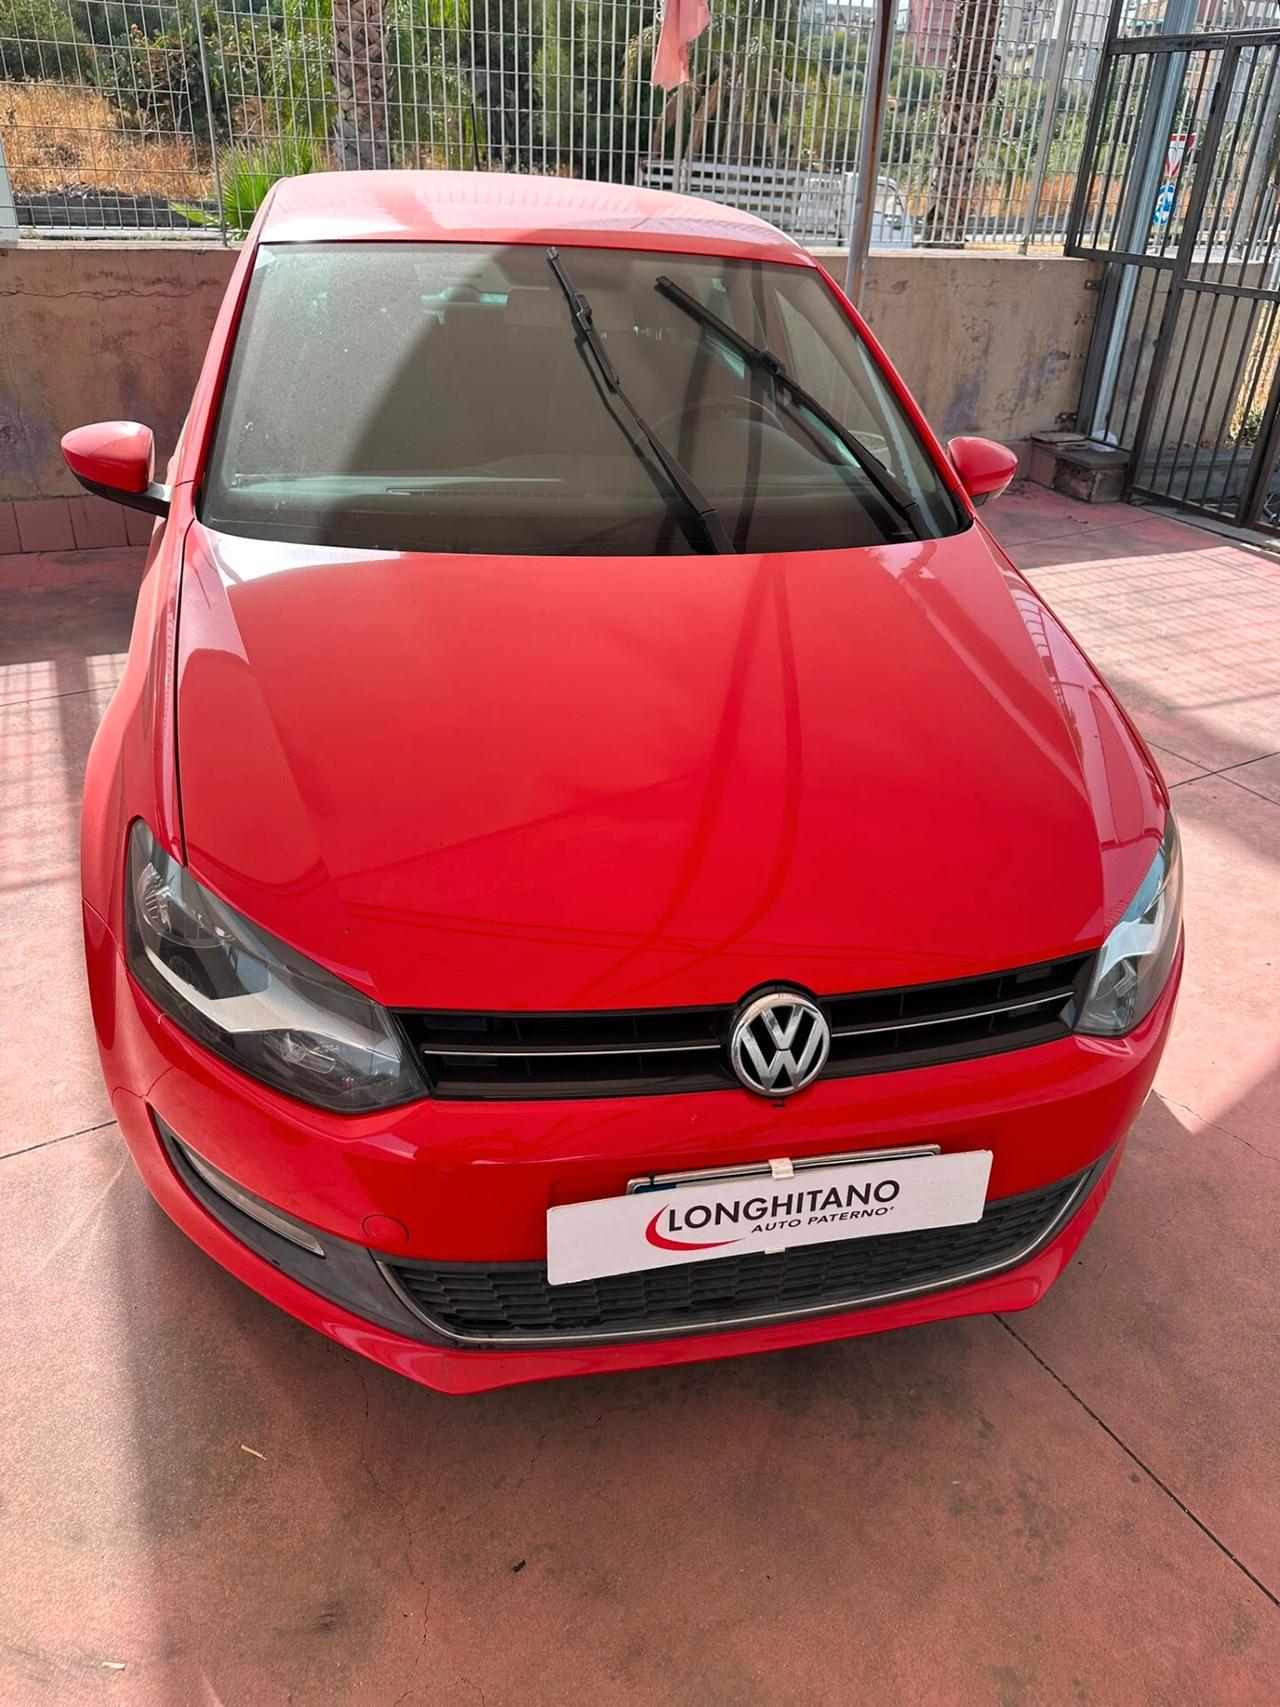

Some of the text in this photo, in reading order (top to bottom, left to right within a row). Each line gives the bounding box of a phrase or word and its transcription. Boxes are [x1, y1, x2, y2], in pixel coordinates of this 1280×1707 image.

[738, 1003, 824, 1092] VW
[668, 1179, 901, 1232] LONGHITANO
[751, 1218, 801, 1233] AUTO
